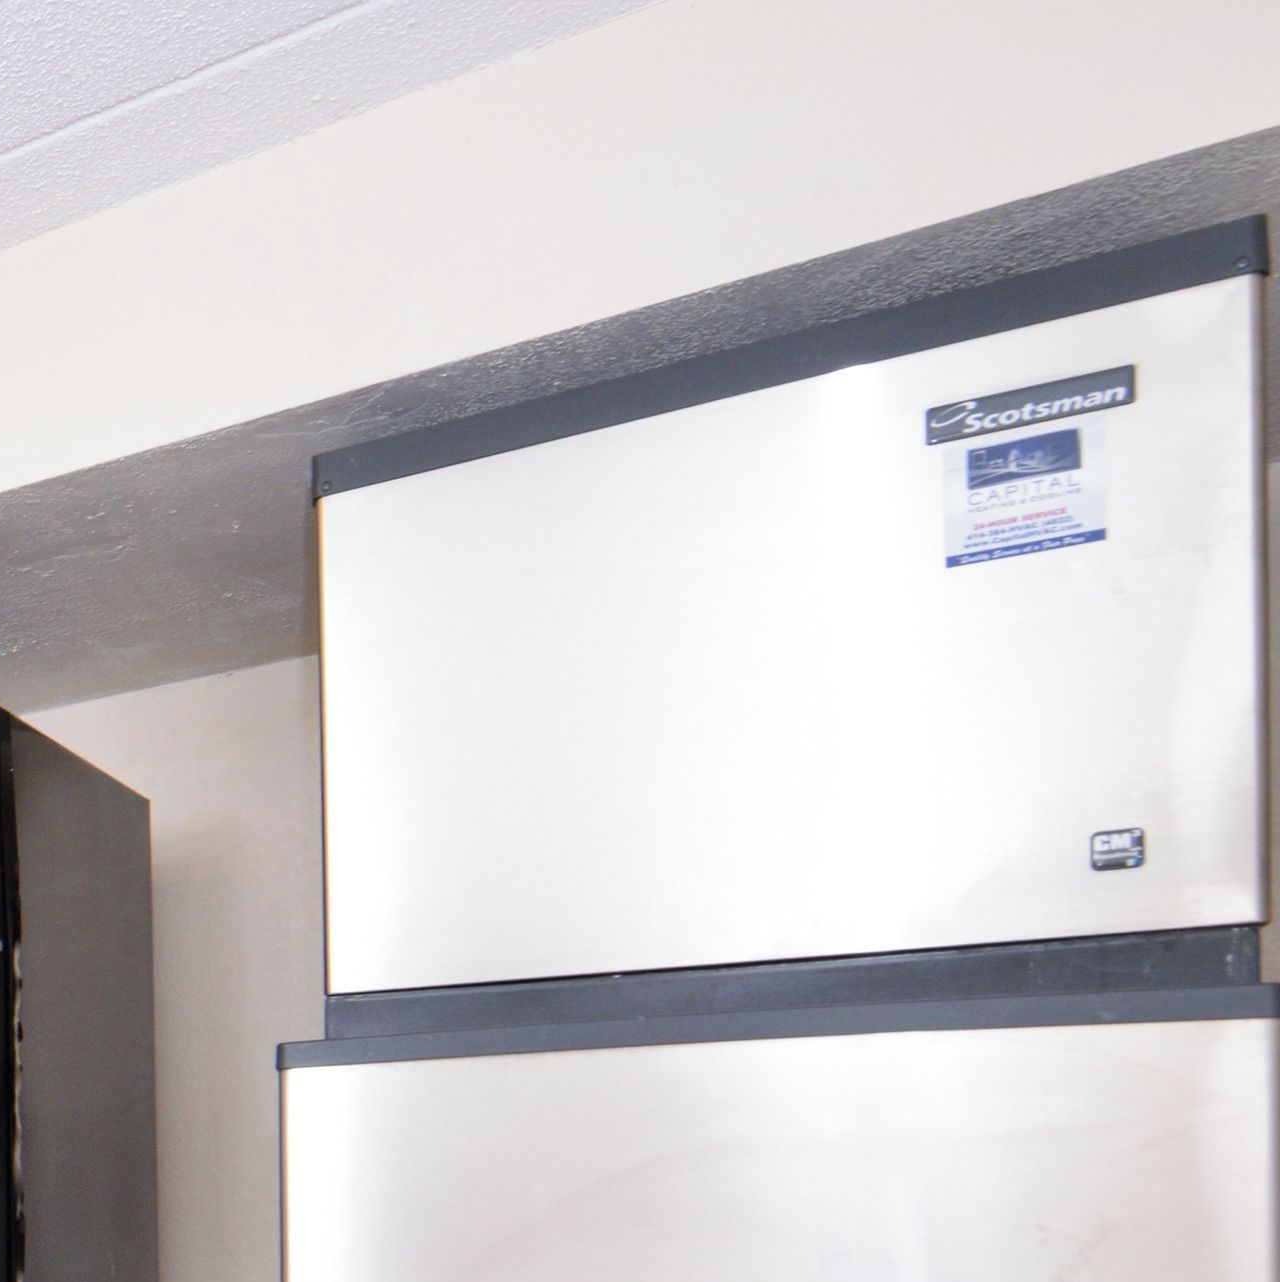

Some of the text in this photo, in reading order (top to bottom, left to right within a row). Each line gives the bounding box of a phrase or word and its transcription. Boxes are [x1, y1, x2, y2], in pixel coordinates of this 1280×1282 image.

[963, 386, 1128, 434] Scotsman
[967, 474, 1081, 506] CAPITAL
[1021, 507, 1067, 521] SERVICE
